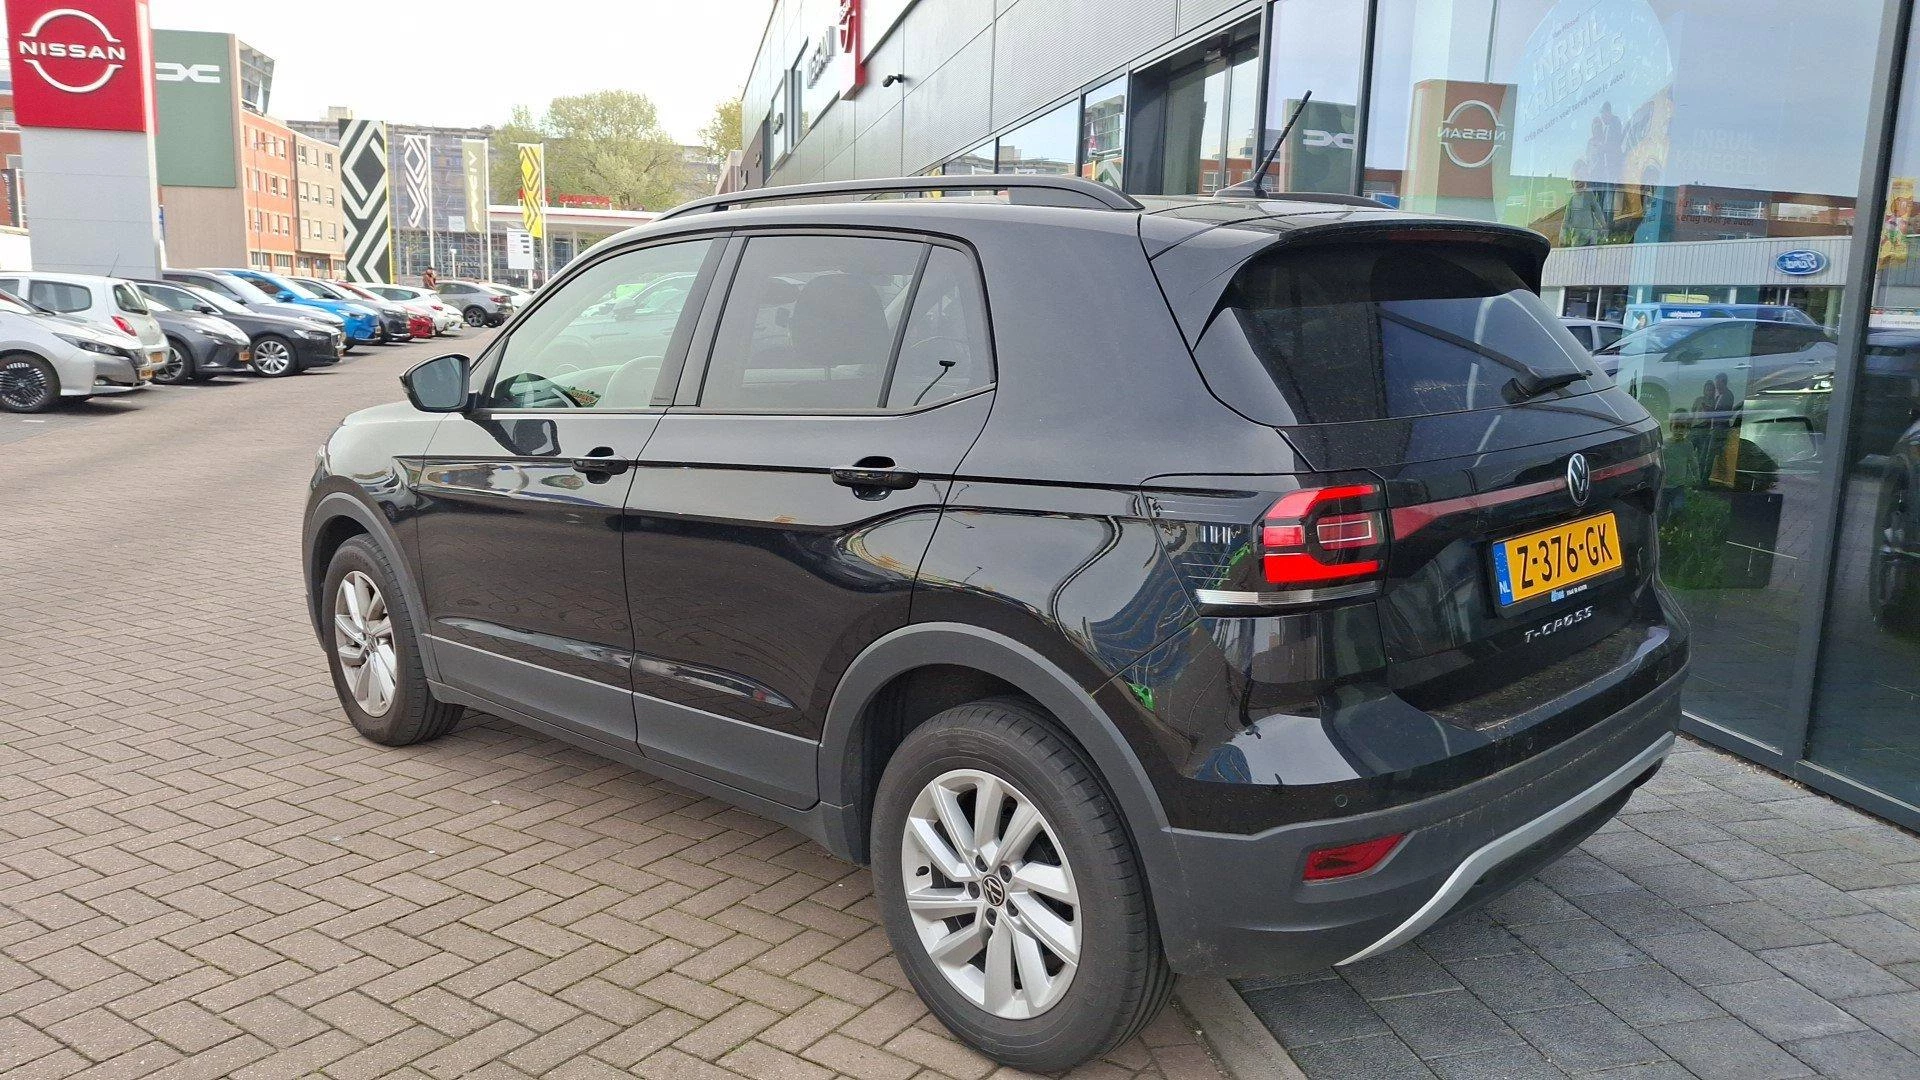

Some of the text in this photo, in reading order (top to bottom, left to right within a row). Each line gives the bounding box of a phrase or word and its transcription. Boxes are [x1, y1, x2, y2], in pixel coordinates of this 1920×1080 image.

[19, 40, 126, 61] NISSAN
[1517, 522, 1613, 590] Z-376-GK
[1498, 580, 1511, 595] NL
[1523, 605, 1594, 644] T-CROSS
